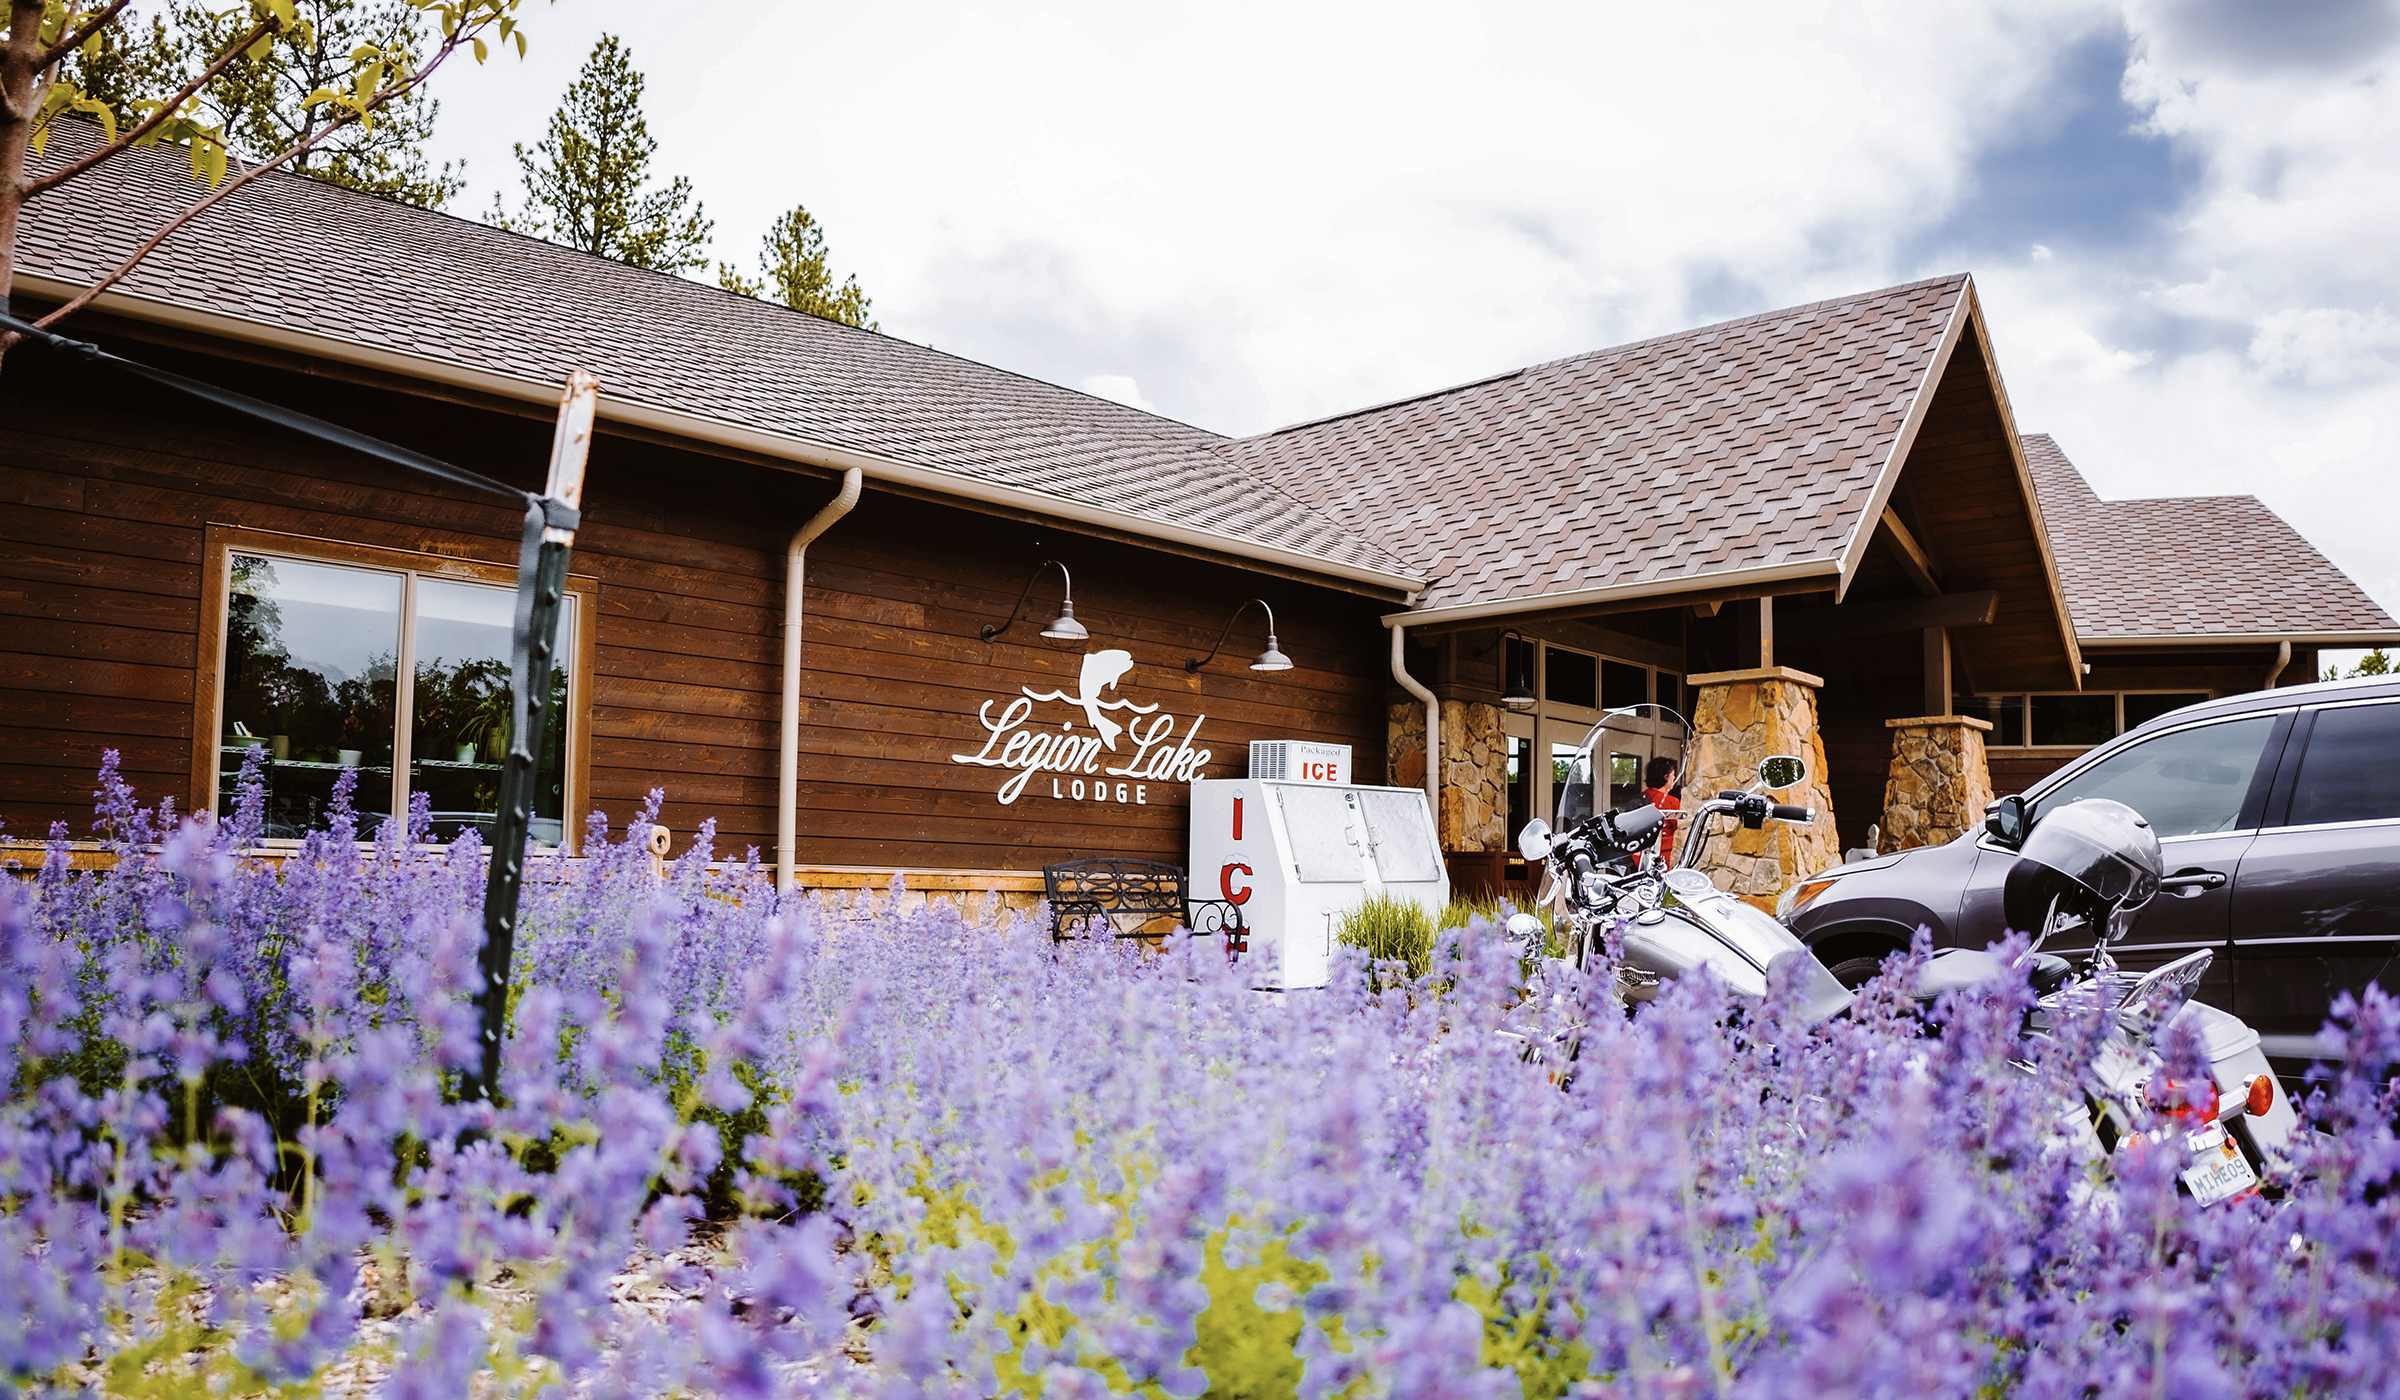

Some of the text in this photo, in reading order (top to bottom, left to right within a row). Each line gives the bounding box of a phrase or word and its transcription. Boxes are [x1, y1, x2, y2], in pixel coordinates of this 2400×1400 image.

[951, 697, 1212, 805] Legion Lake
[1300, 745, 1341, 757] Packaged
[1303, 762, 1337, 781] ICE
[1052, 777, 1147, 805] LODGE
